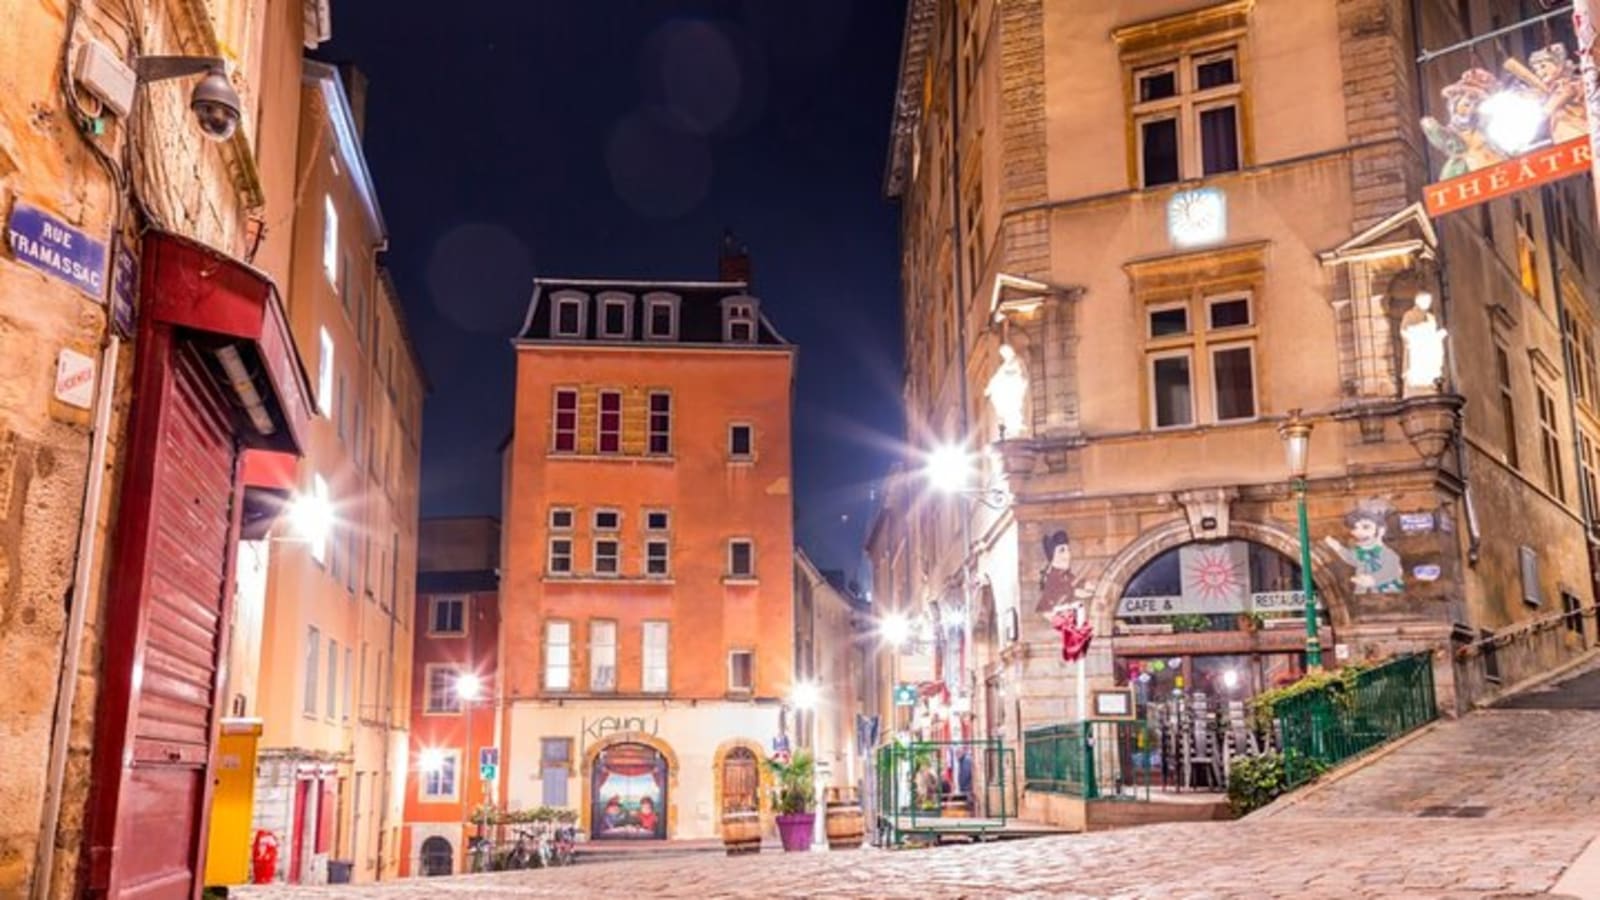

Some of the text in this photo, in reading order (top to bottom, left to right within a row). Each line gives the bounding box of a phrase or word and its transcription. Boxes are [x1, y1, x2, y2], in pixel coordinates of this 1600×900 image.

[42, 221, 72, 249] RUE
[9, 229, 101, 288] TRAMASSAC
[1163, 599, 1173, 610] &
